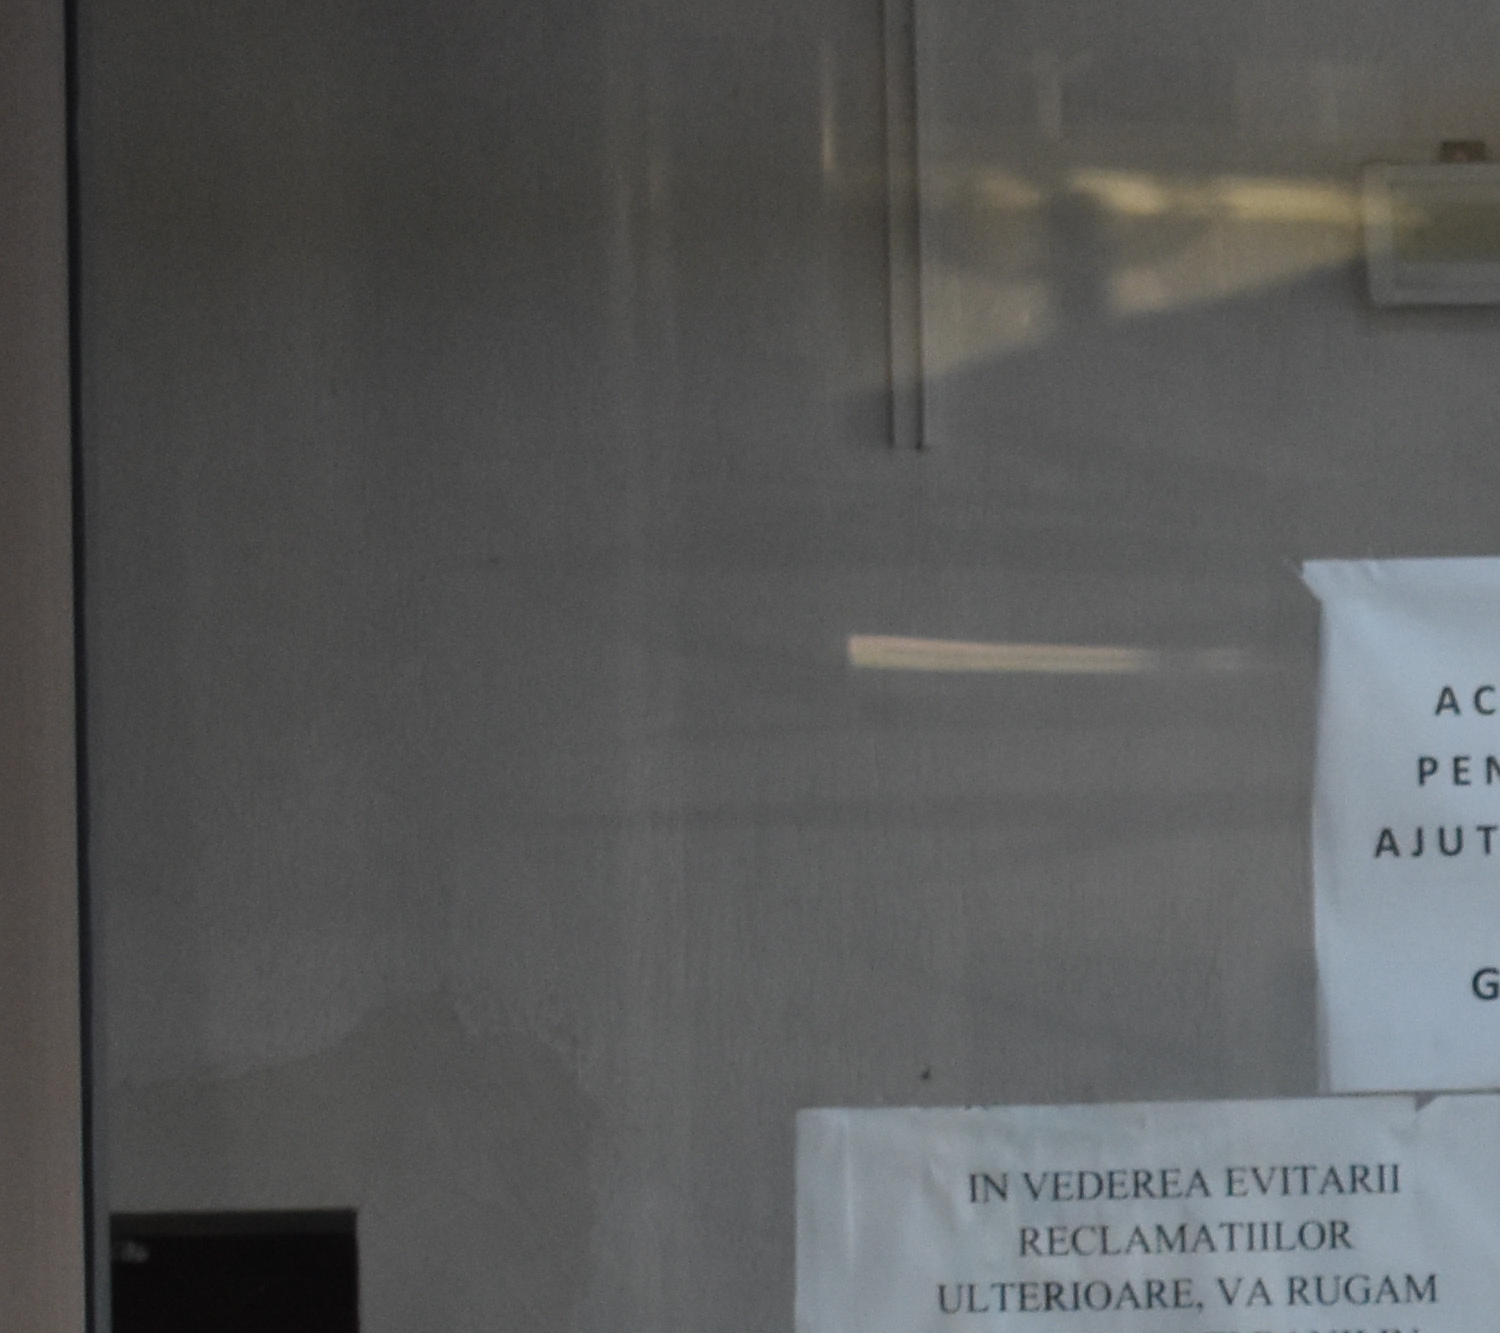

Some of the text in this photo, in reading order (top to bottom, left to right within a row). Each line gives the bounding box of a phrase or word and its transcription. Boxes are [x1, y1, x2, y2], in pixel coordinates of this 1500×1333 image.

[969, 1164, 1399, 1203] IN VEDEREA EVITARII
[1020, 1220, 1352, 1257] RECLAMATIILOR
[939, 1274, 1436, 1313] ULTERIOARE, VA RUGAM
